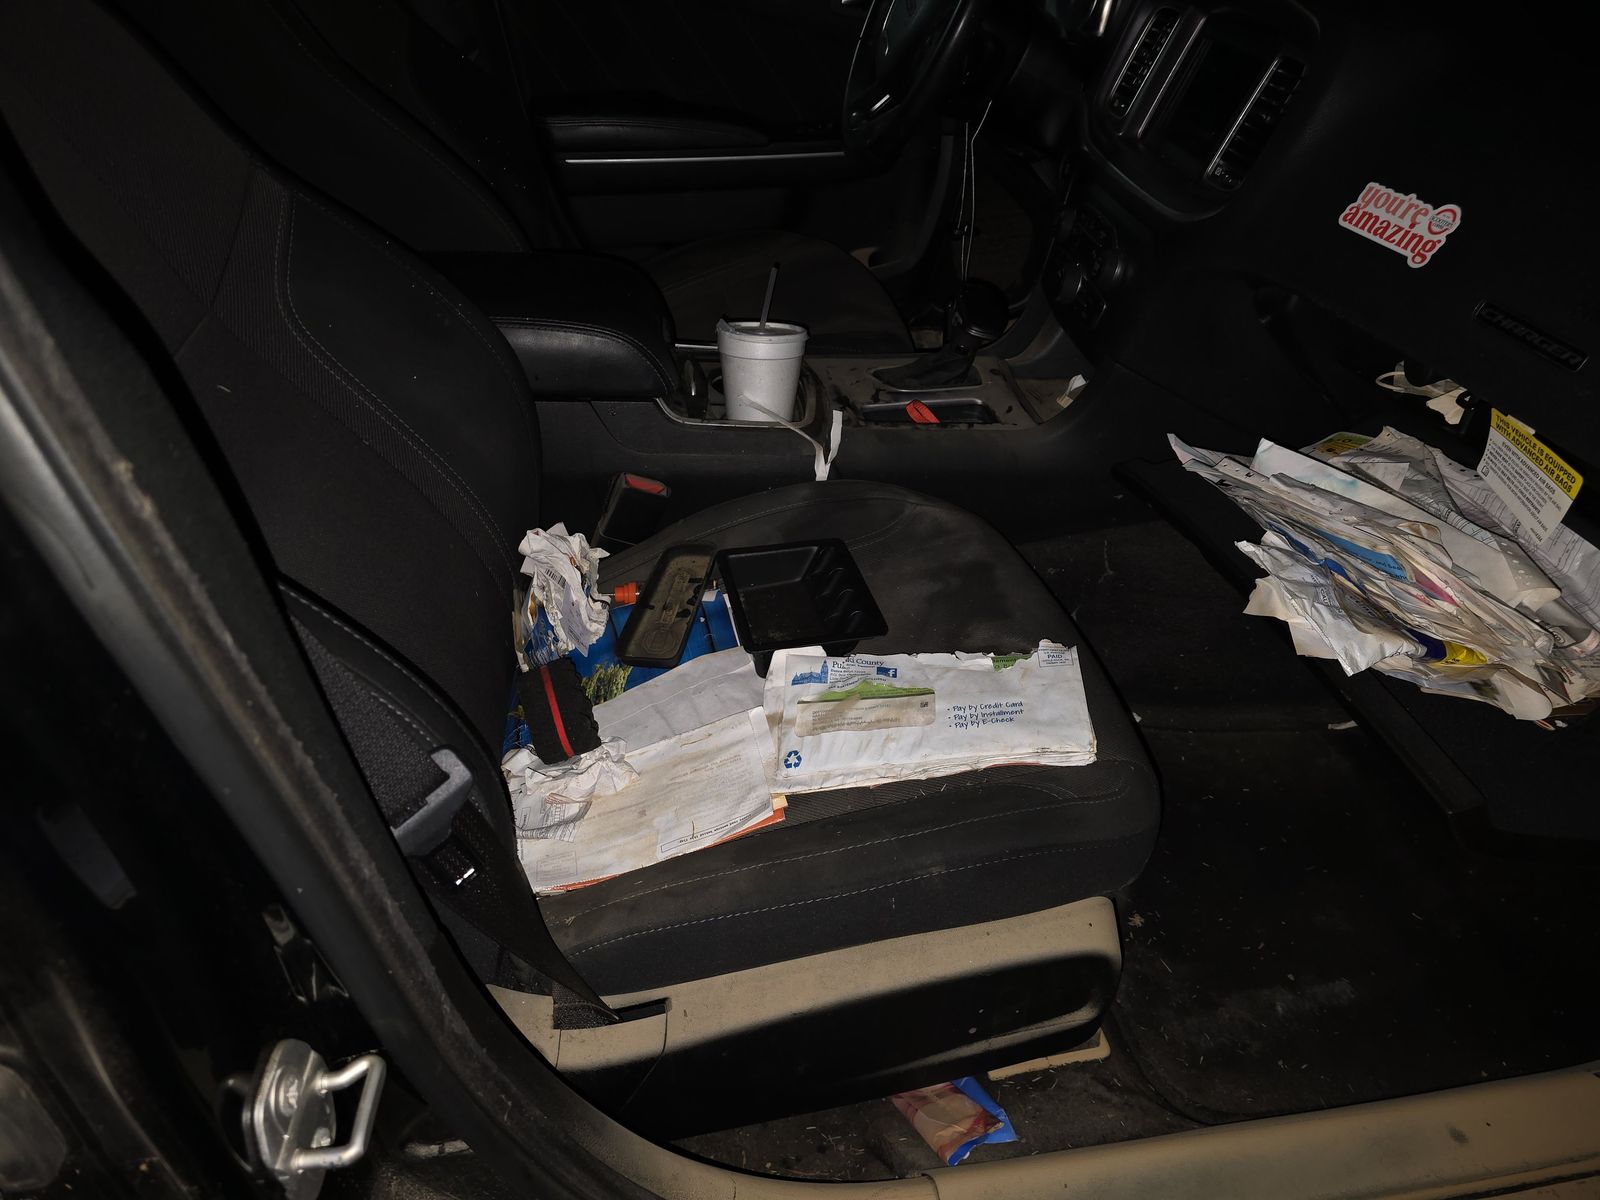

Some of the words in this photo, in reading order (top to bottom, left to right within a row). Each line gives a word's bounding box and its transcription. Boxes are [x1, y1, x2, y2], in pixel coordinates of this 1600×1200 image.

[1360, 186, 1429, 224] you're
[1342, 204, 1441, 264] amazing
[1496, 422, 1511, 439] WITH
[1512, 436, 1543, 467] ADVANCED
[1543, 463, 1555, 477] AIR
[1554, 474, 1573, 493] BAGS
[1511, 424, 1537, 448] VEHICLE
[1537, 447, 1545, 457] IS
[1545, 453, 1576, 484] EQUIPPED
[855, 658, 885, 666] County
[953, 705, 966, 713] Pay
[969, 704, 978, 712] by
[980, 702, 1003, 710] Credit
[981, 709, 1024, 718] Installment
[955, 722, 968, 730] Pay
[971, 720, 980, 728] by
[982, 717, 1014, 725] E-Check
